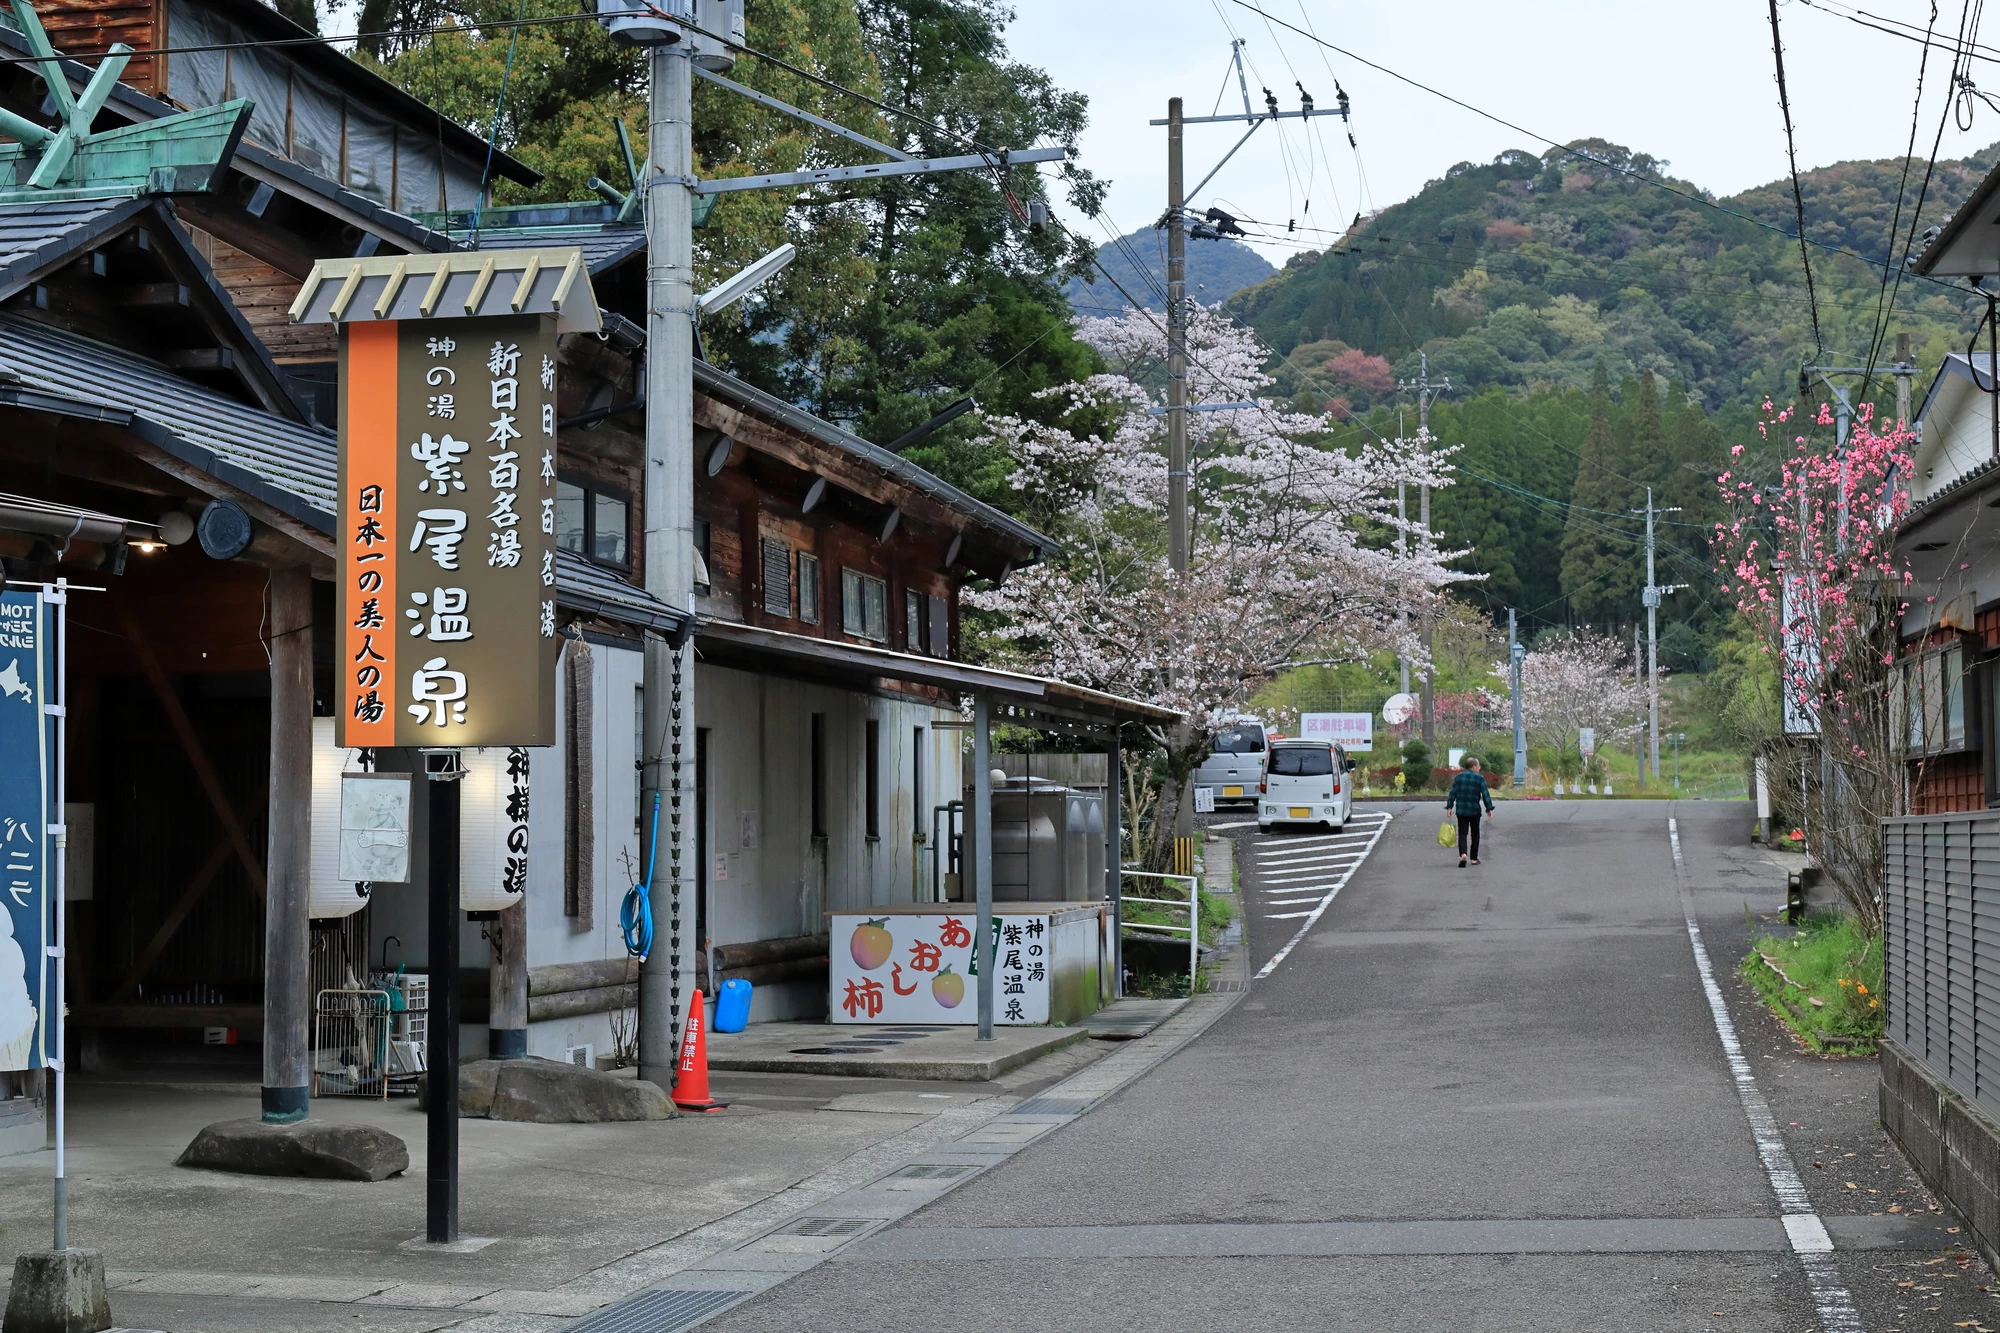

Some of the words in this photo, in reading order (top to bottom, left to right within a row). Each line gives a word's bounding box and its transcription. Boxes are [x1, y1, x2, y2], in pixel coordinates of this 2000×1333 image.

[426, 336, 456, 420] 神の湯
[485, 340, 522, 568] 新日本百名湯
[540, 353, 555, 638] 新日本百名湯
[353, 484, 387, 724] 日本一の美人の湯
[405, 432, 473, 726] 紫尾温泉
[1002, 925, 1026, 1021] 紫尾温泉
[1025, 918, 1046, 982] 神の湯
[681, 1018, 699, 1072] 駐車禁止
